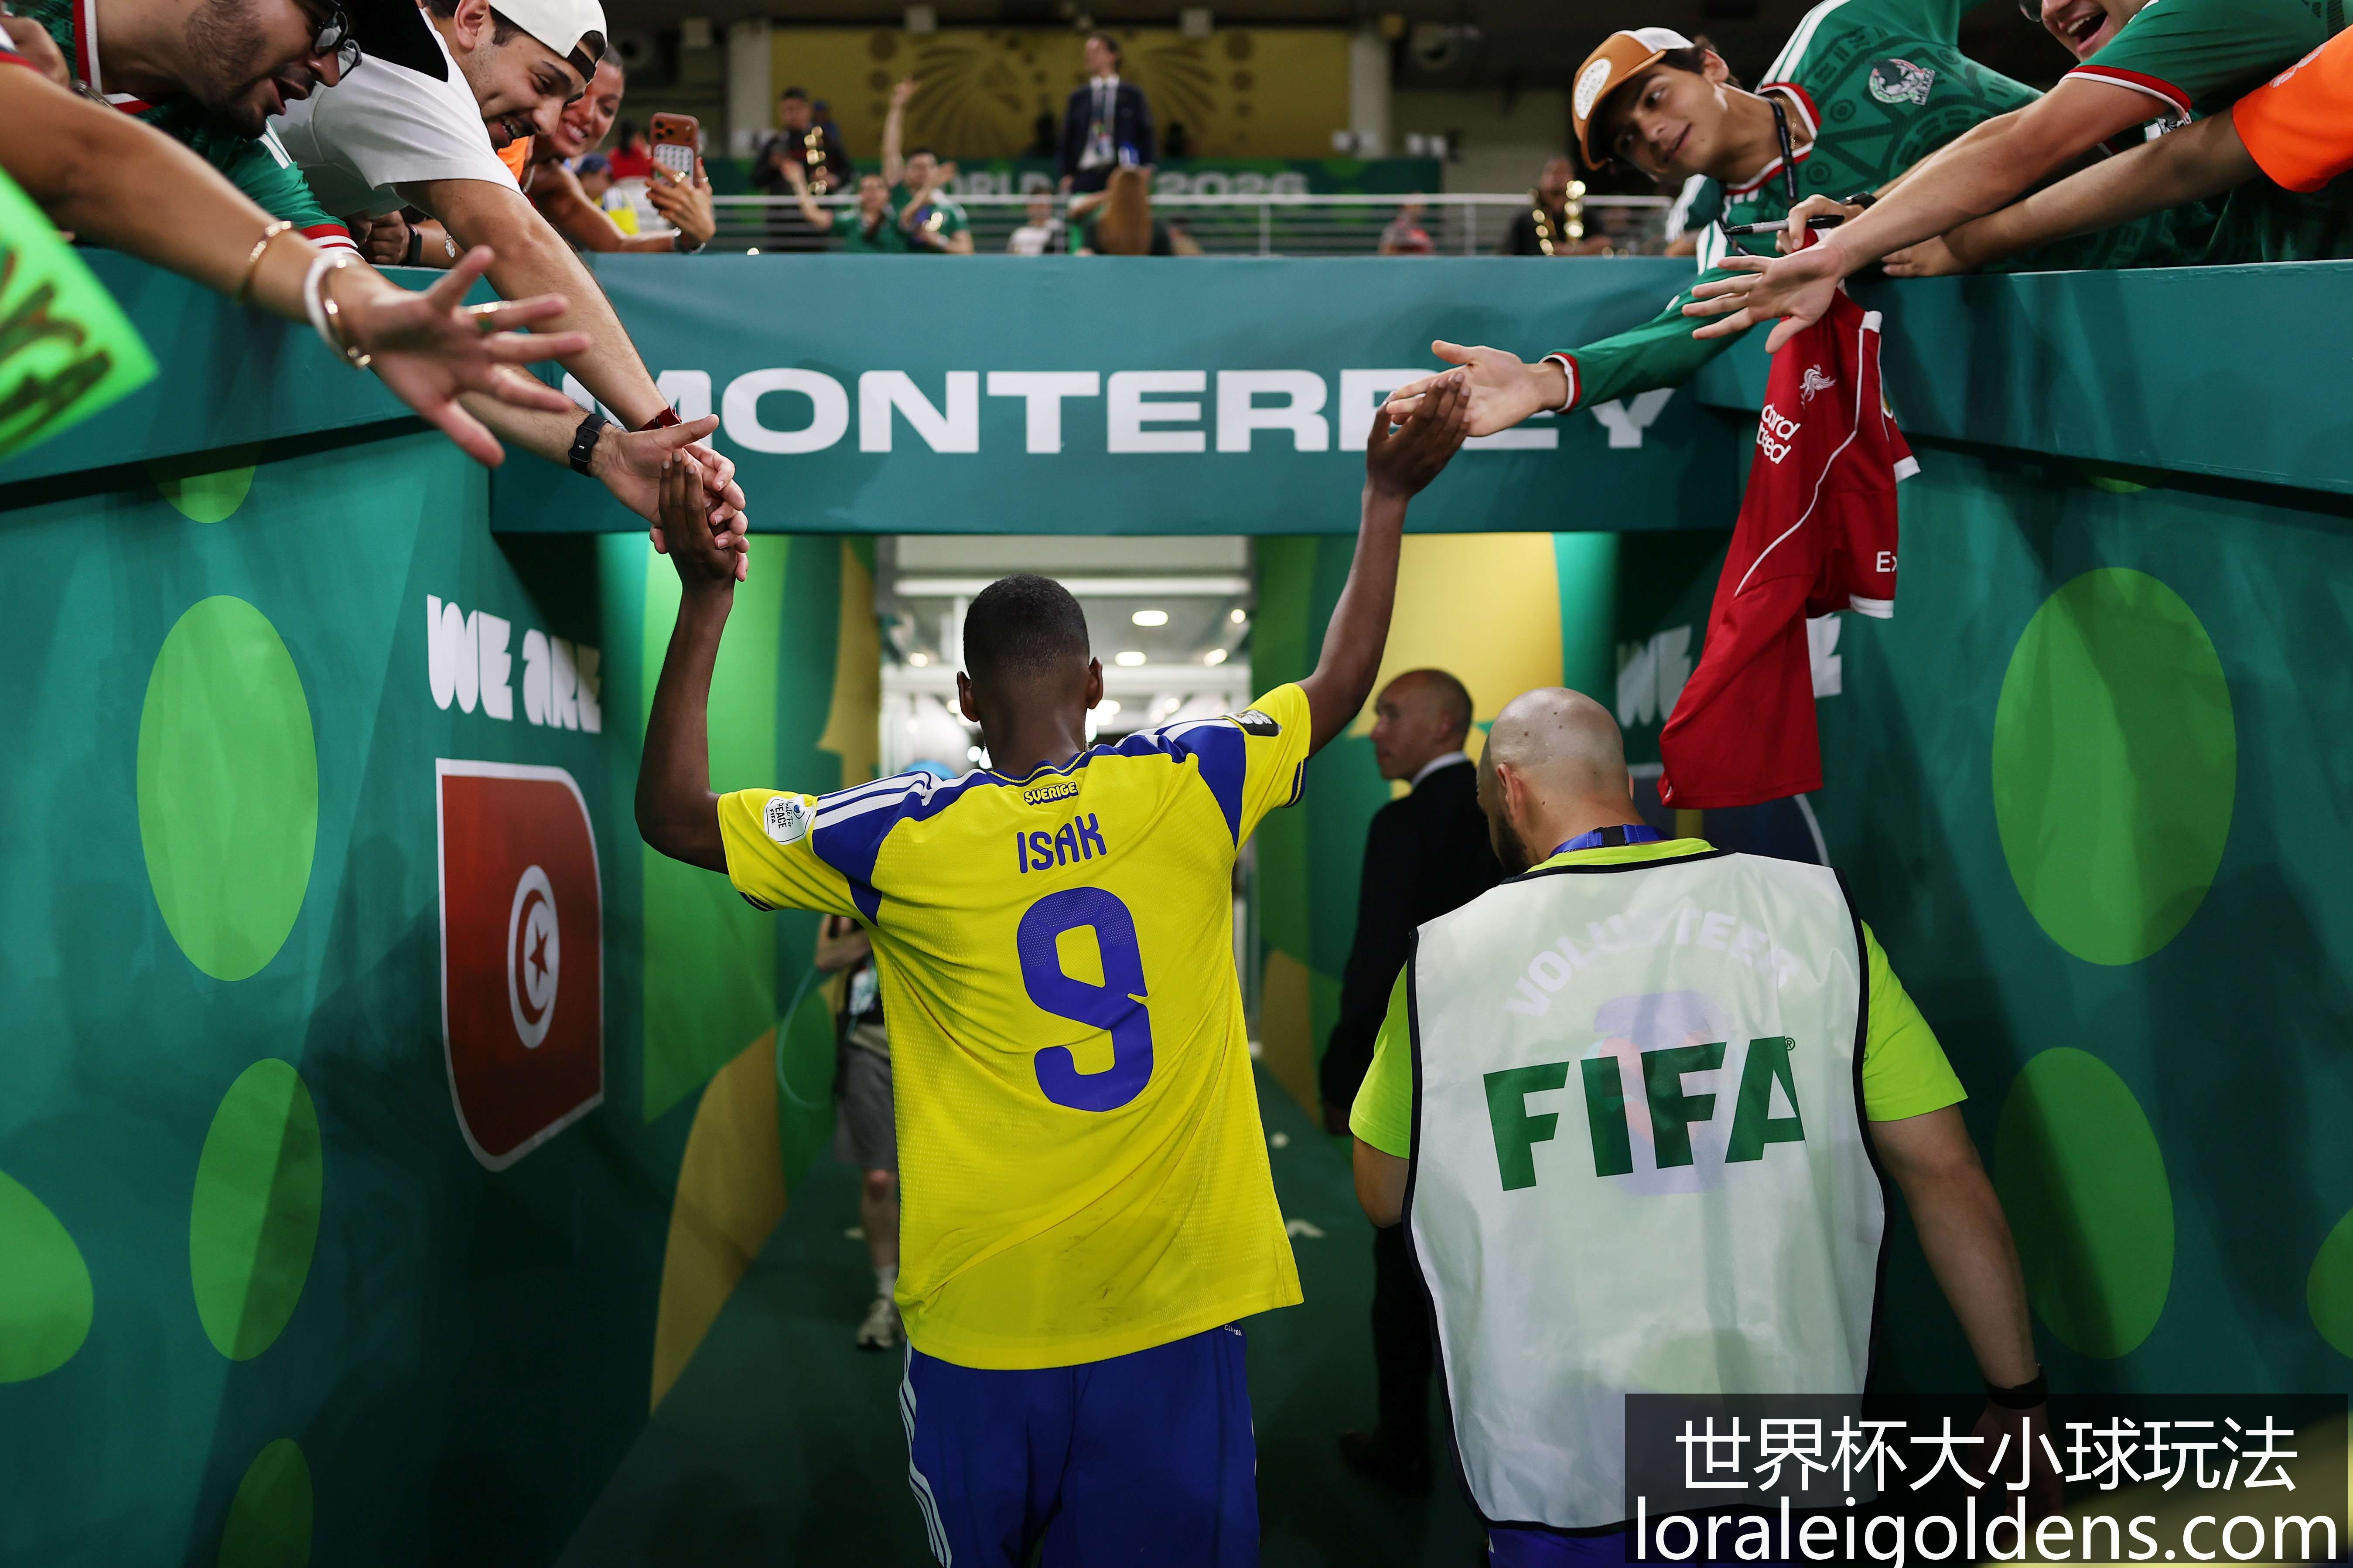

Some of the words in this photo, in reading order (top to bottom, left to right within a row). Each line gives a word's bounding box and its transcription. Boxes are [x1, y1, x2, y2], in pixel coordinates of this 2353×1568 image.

[426, 593, 513, 722] WE
[775, 802, 787, 829] PEACE
[1023, 781, 1079, 806] SVERIGE
[1017, 813, 1107, 874] ISAK
[1017, 886, 1154, 1113] 9
